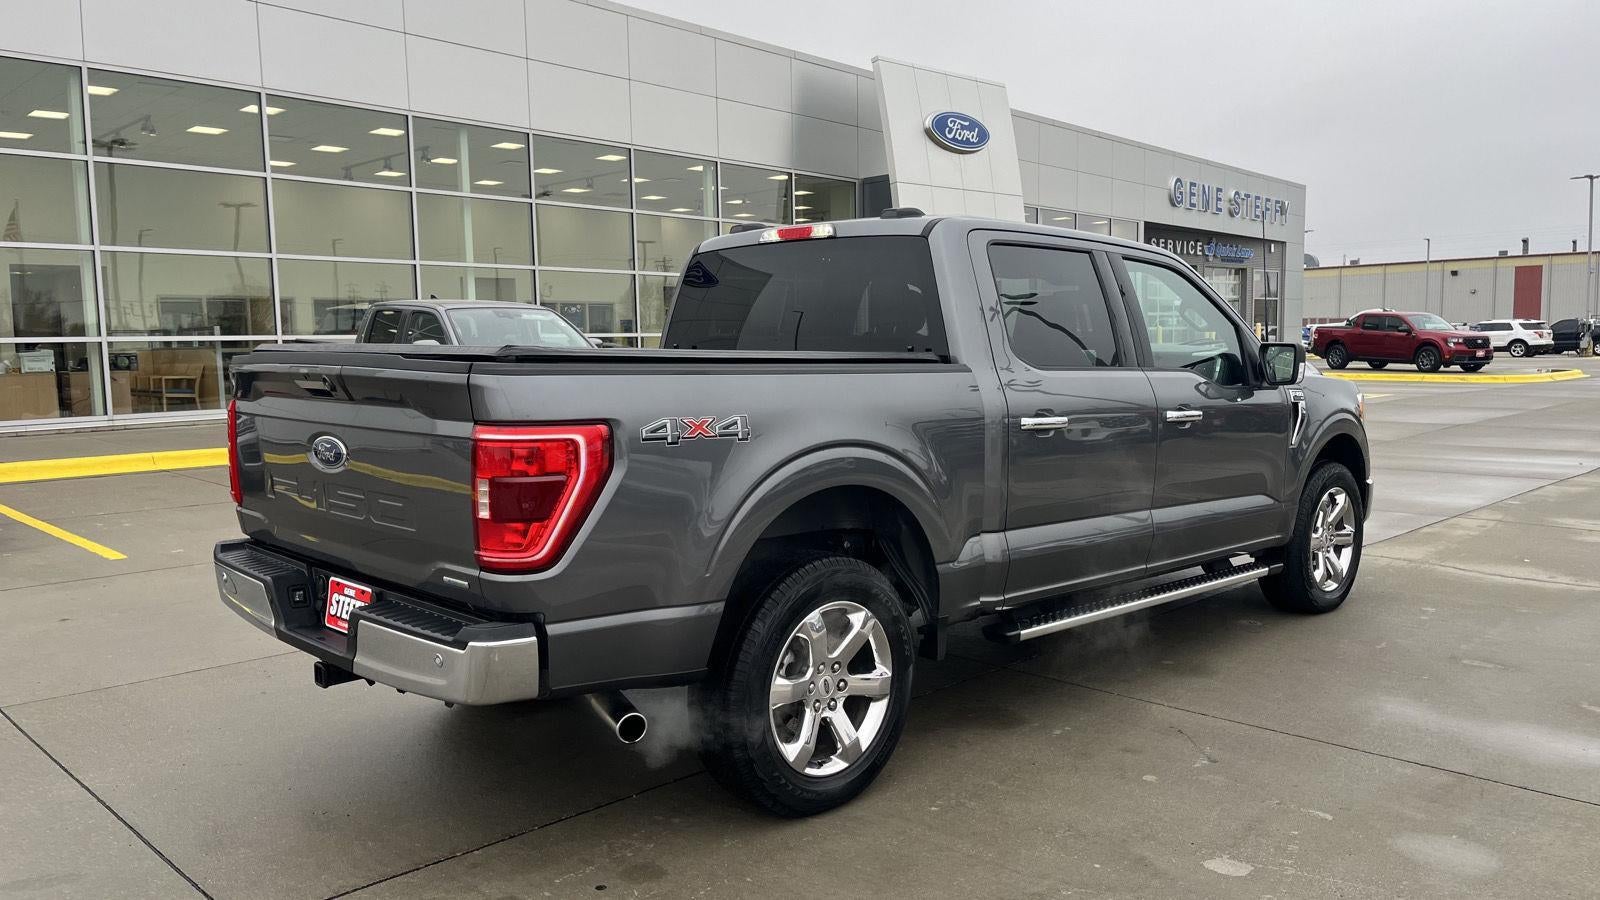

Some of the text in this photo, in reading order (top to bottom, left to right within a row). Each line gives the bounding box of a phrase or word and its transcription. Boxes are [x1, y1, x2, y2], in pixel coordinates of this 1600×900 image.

[945, 117, 979, 143] Ford
[1171, 176, 1290, 225] GENE STEFFY
[1150, 237, 1203, 256] SERVICE
[317, 442, 336, 462] Ford
